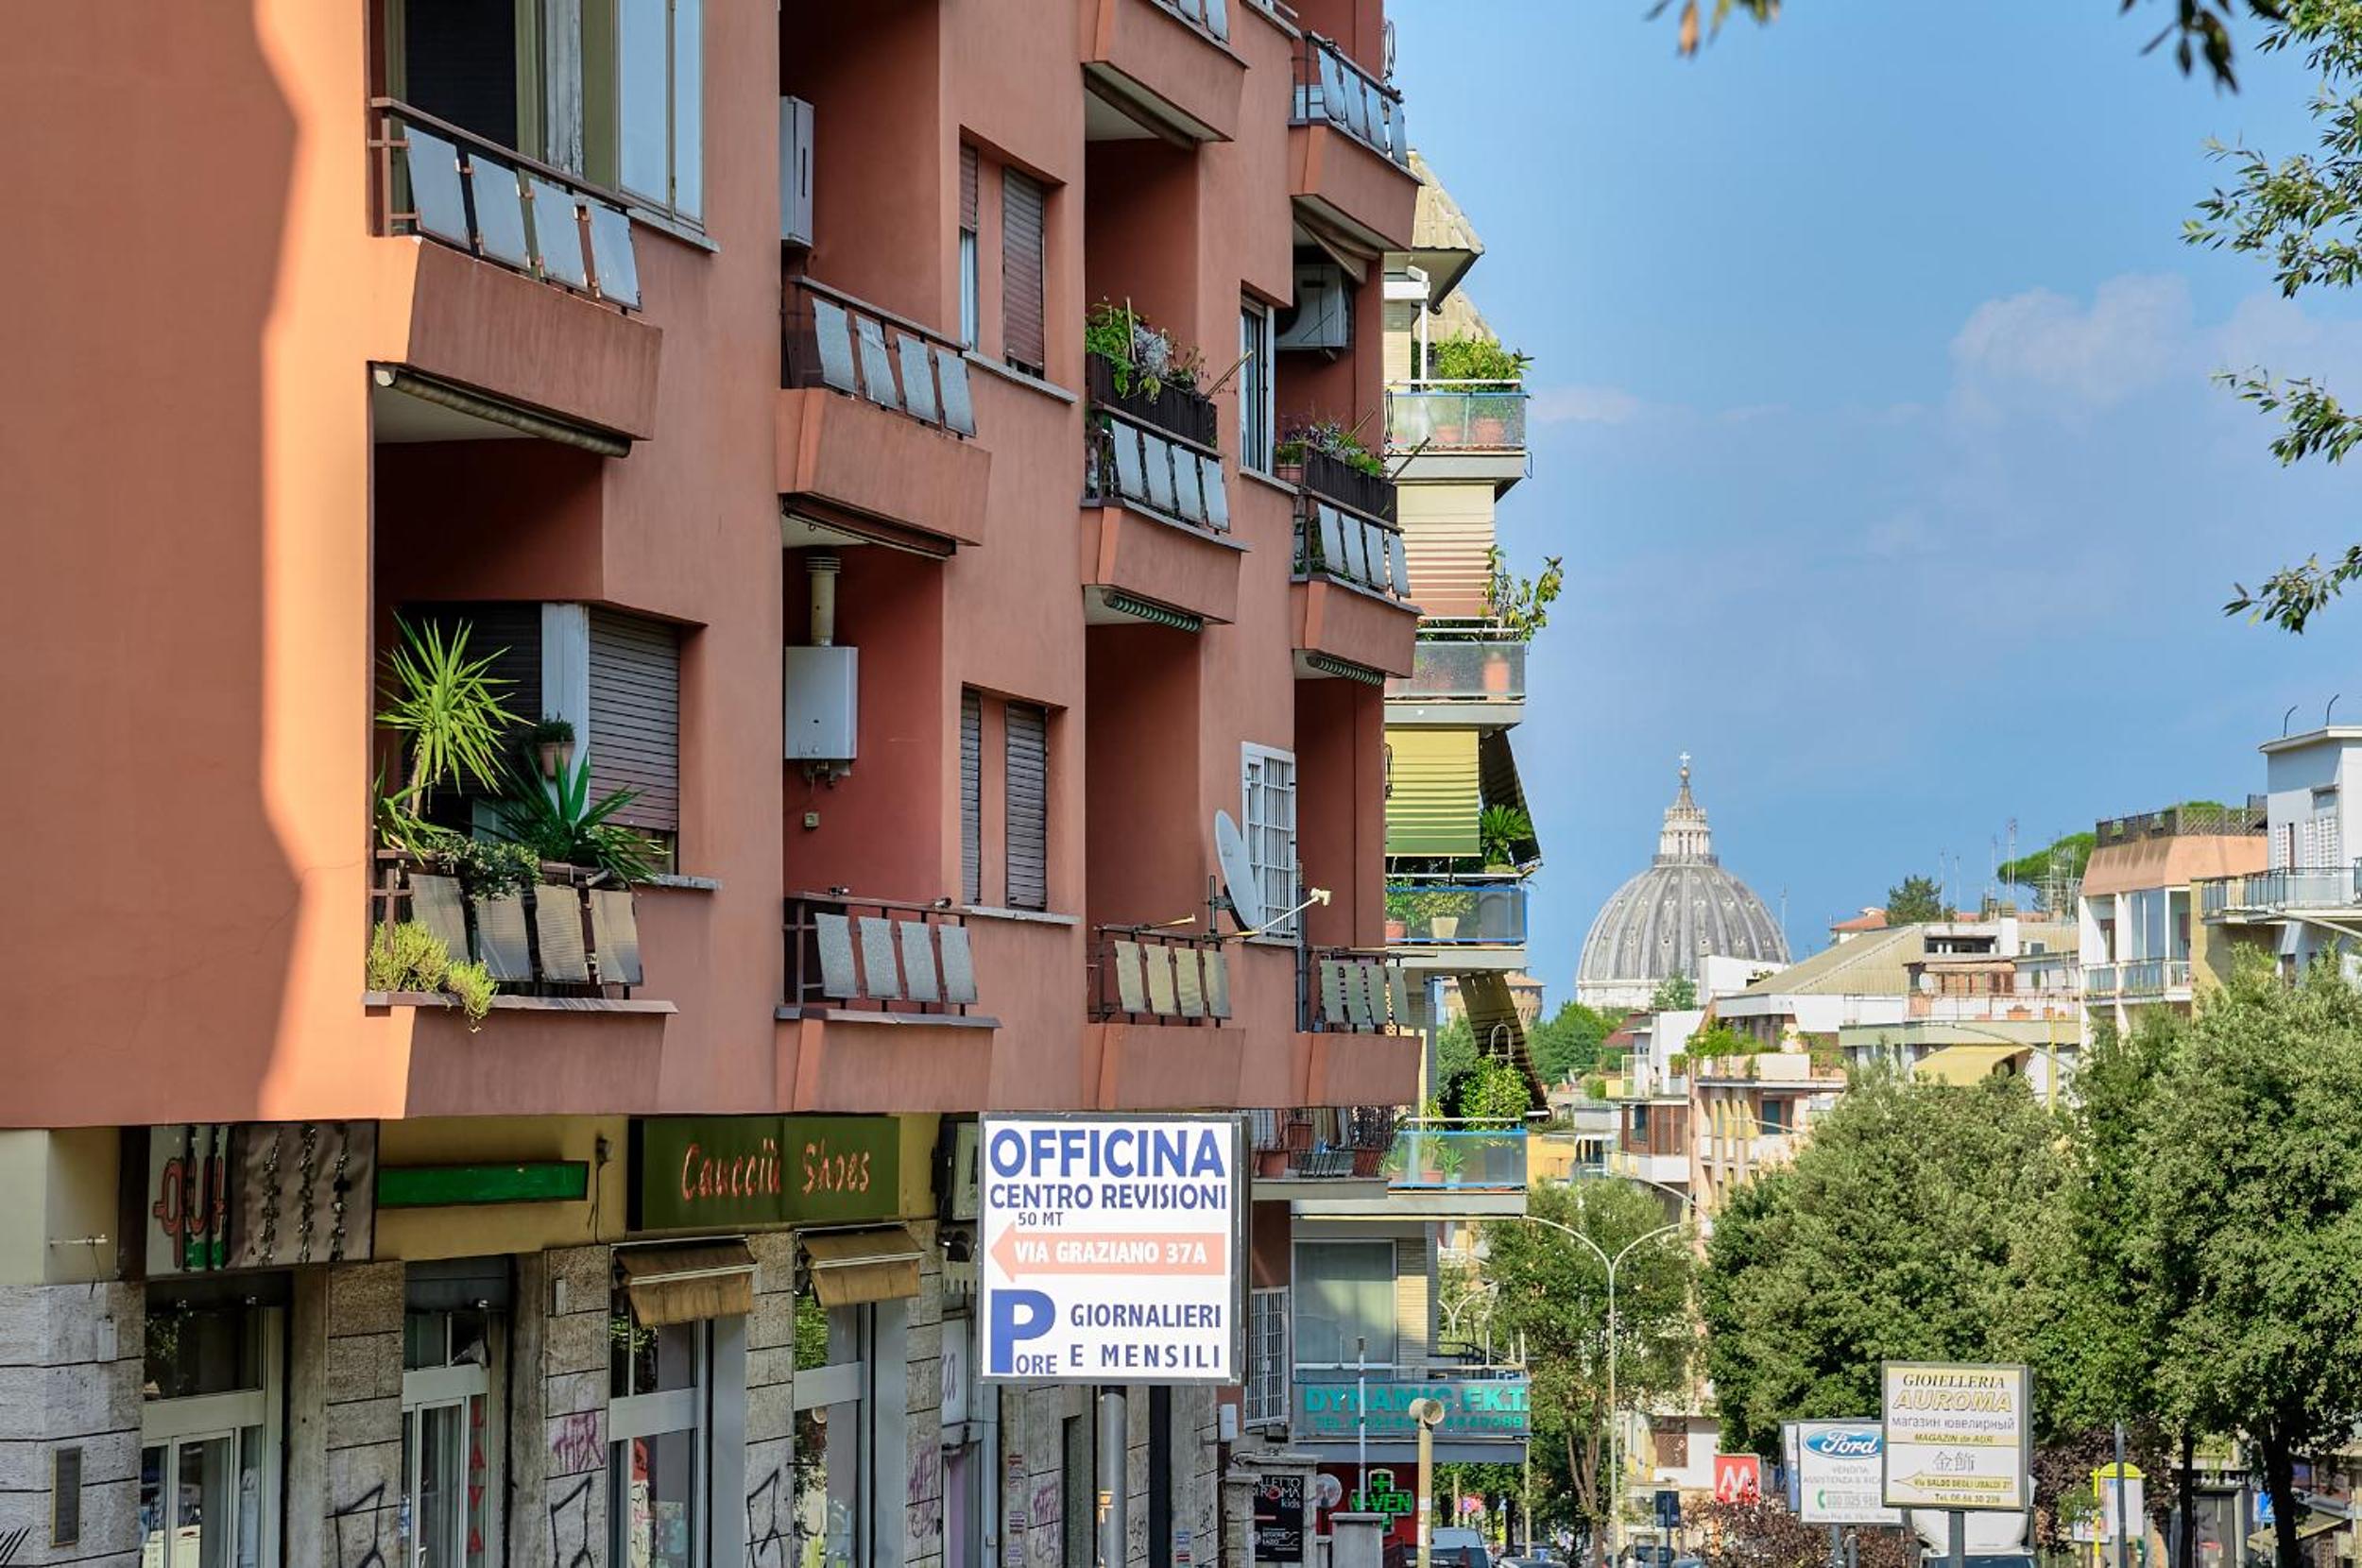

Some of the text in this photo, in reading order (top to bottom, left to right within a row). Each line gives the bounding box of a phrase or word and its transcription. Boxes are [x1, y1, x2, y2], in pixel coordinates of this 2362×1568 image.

[990, 1129, 1225, 1178] OFFICINA
[802, 1137, 870, 1194] Shoes
[990, 1185, 1226, 1209] CENTRO REVISIONI
[1018, 1212, 1064, 1226] 50 MT
[1015, 1242, 1207, 1264] VIA GRAZIANO 37A
[1070, 1304, 1222, 1328] GIORNALIERI
[990, 1289, 1056, 1373] P
[1016, 1355, 1057, 1374] ORE
[1070, 1344, 1220, 1368] E MENSILI
[1903, 1373, 2004, 1389] GIOIELLERIA
[1892, 1389, 2012, 1412] AUROMA
[1892, 1417, 2014, 1431] магазин ювелирный
[1821, 1431, 1878, 1454] Ford
[1914, 1433, 1958, 1442] MAGAZIN
